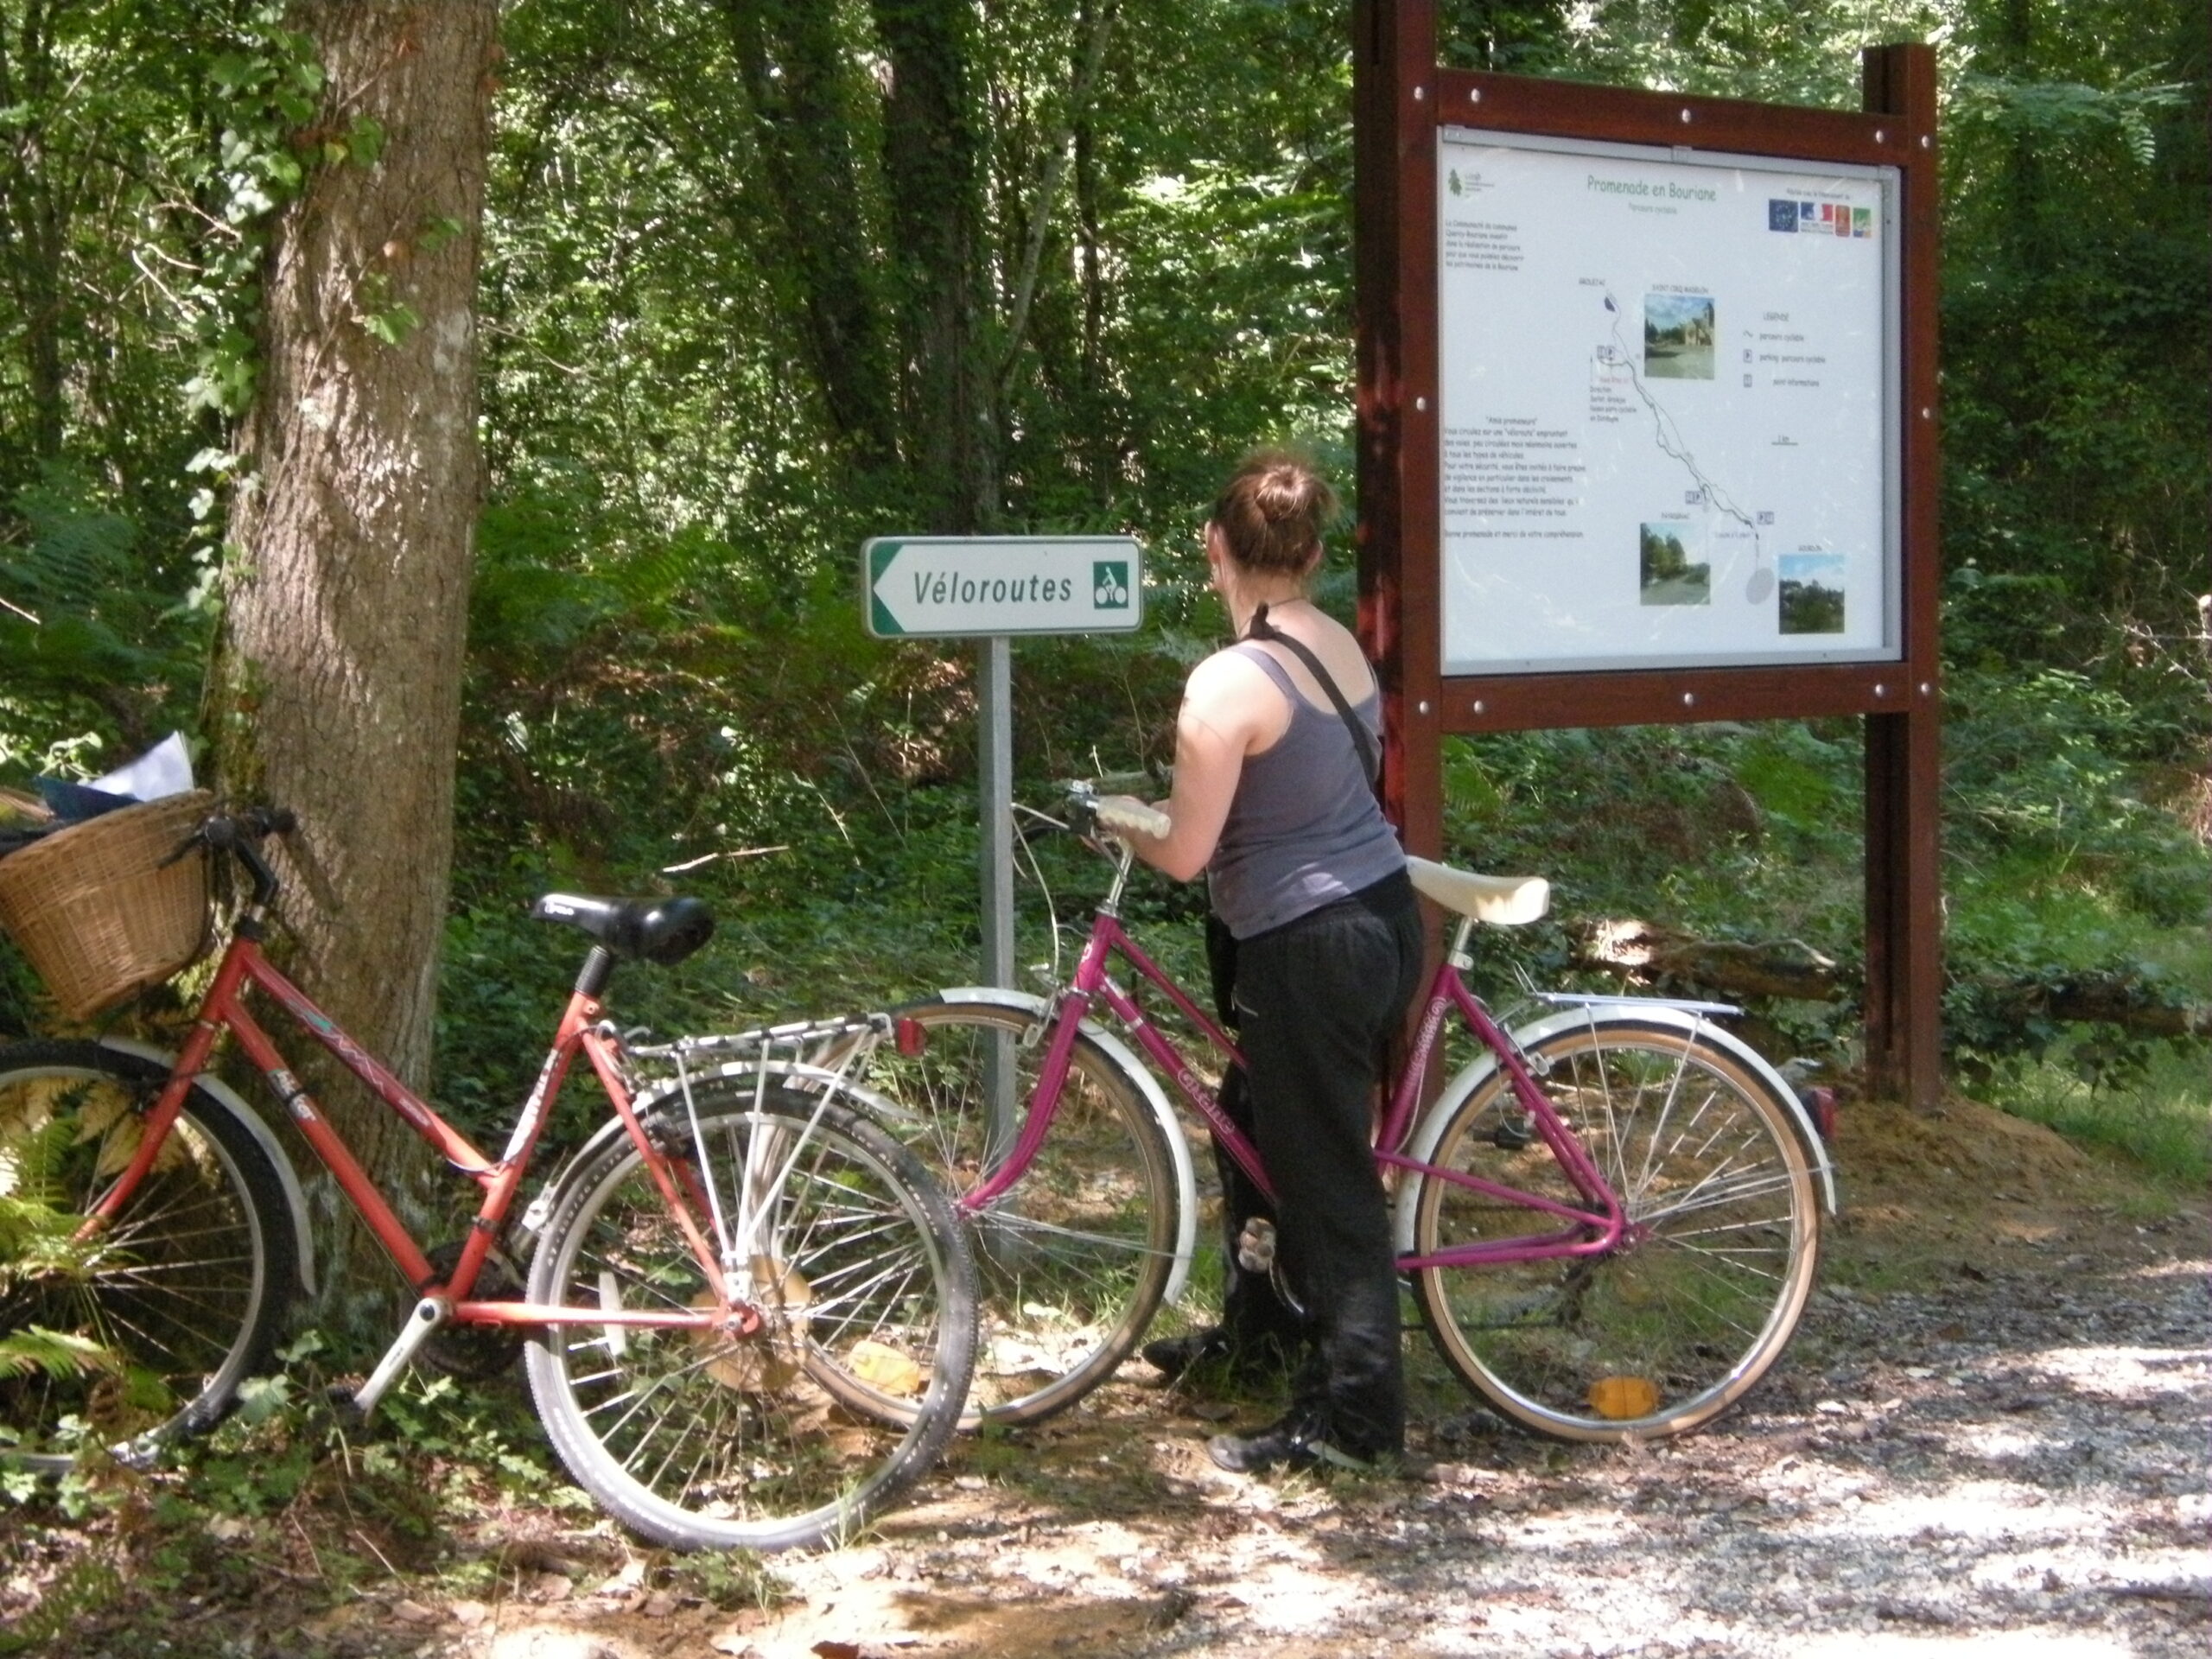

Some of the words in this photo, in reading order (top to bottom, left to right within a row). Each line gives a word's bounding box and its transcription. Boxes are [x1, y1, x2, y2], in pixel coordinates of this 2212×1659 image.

[1587, 175, 1649, 195] Promenade
[1652, 185, 1666, 197] en
[1669, 182, 1717, 201] Bouriane
[913, 570, 1073, 605] Véloroutes
